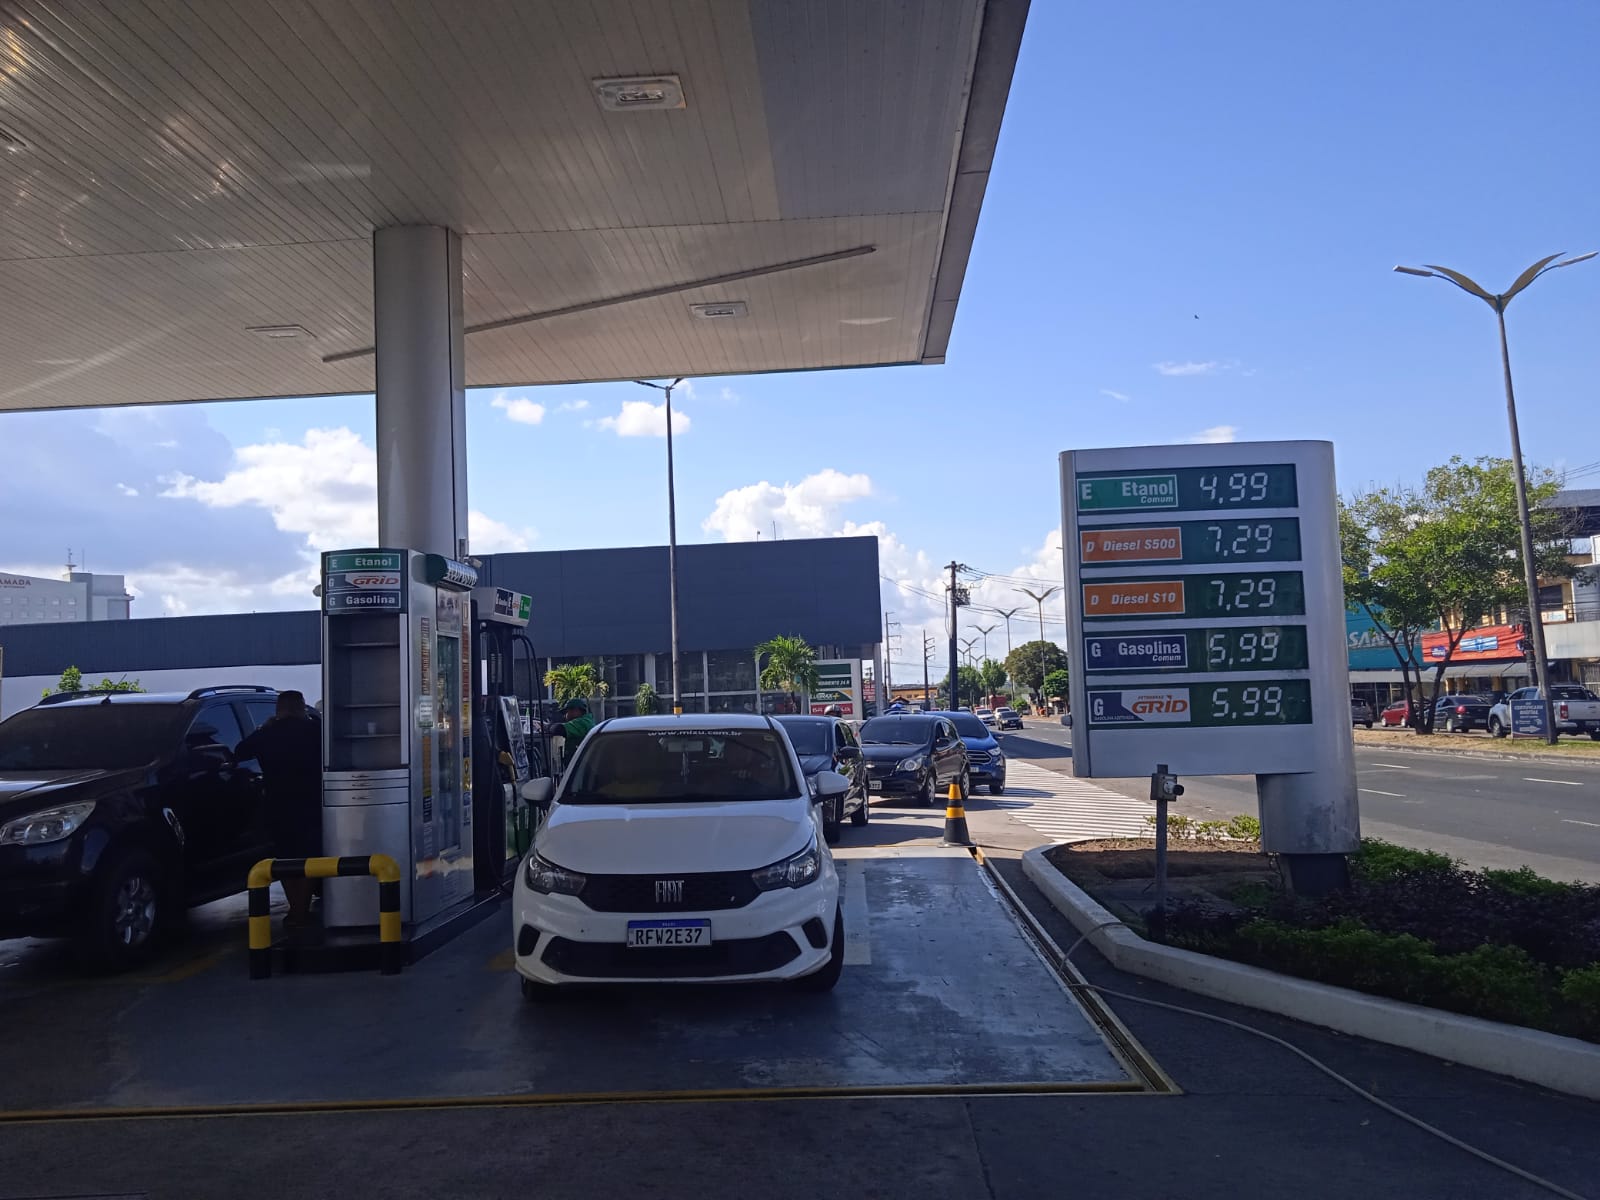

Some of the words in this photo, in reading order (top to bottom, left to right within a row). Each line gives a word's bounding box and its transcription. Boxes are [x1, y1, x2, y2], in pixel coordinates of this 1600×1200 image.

[1082, 482, 1092, 500] E
[1122, 480, 1174, 497] Etanol
[1199, 472, 1268, 504] 4,99
[1140, 495, 1174, 504] Comum
[1086, 540, 1095, 553] D
[1102, 539, 1141, 552] Diesel
[1144, 538, 1176, 551] S500
[1206, 524, 1273, 556] 7,29
[355, 558, 392, 566] Etanol
[352, 576, 399, 585] GRID
[346, 595, 395, 604] Gasolina
[1090, 594, 1099, 606] D
[1111, 593, 1149, 605] Diesel
[1152, 592, 1176, 604] S10
[1210, 578, 1276, 610] 7,29
[1091, 642, 1102, 658] G
[1118, 641, 1182, 656] Gasolina
[1209, 632, 1279, 664] 5,99
[1152, 654, 1182, 662] Comum
[1094, 698, 1104, 716] G
[1132, 695, 1188, 713] GRID
[1212, 686, 1282, 719] 5,99
[655, 880, 684, 903] FIAT
[635, 928, 702, 945] RFW2E37
